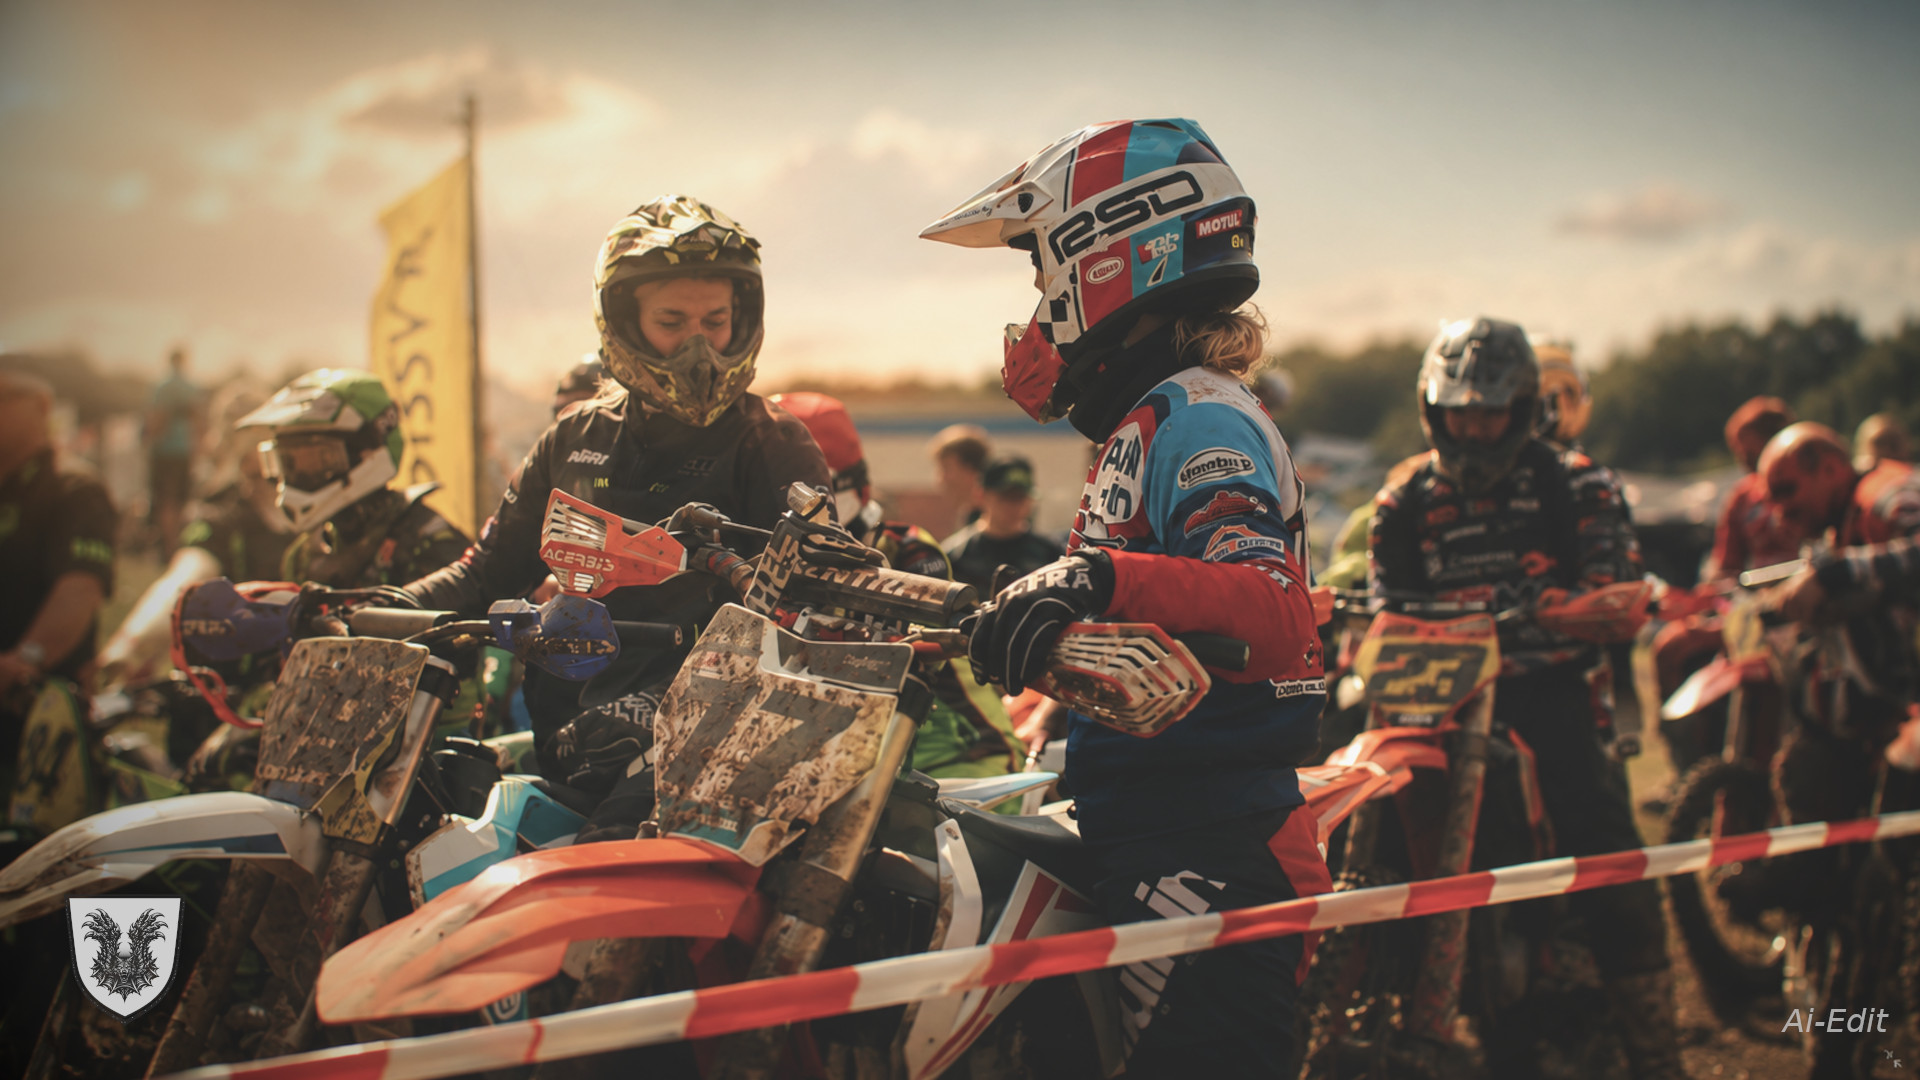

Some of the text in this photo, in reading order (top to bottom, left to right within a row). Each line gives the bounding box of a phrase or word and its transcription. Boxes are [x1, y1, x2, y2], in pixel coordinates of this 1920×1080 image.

[1048, 170, 1204, 266] RSD
[1199, 212, 1241, 237] MOTUL
[543, 548, 615, 572] ACERBIS
